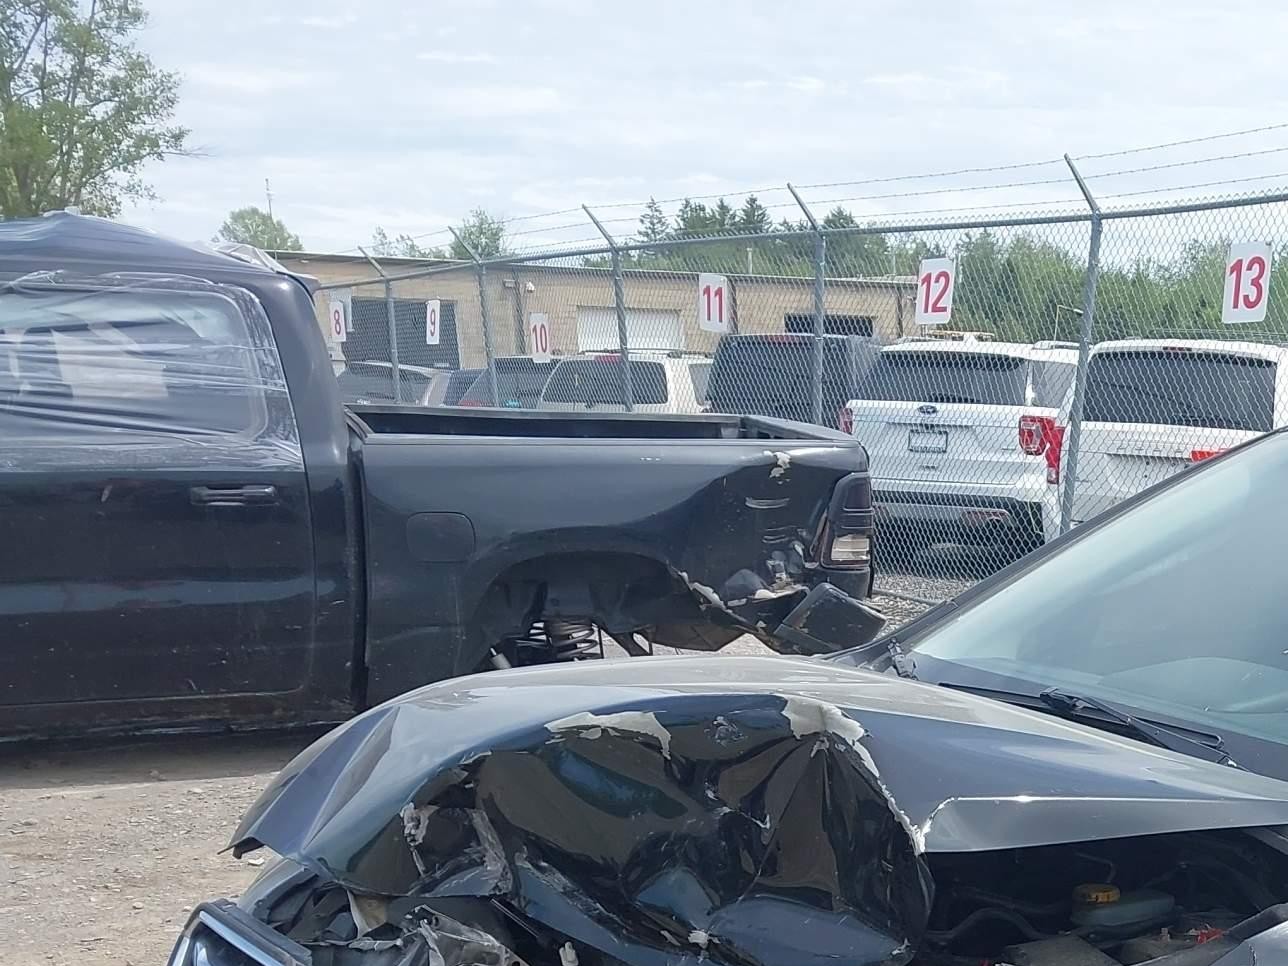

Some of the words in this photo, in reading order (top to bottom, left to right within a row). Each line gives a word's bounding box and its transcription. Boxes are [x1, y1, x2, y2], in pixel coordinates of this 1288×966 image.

[920, 270, 951, 314] 12
[1229, 256, 1265, 309] 13
[703, 285, 723, 323] 11
[333, 310, 342, 335] 8
[429, 308, 436, 337] 9
[532, 323, 548, 353] 10
